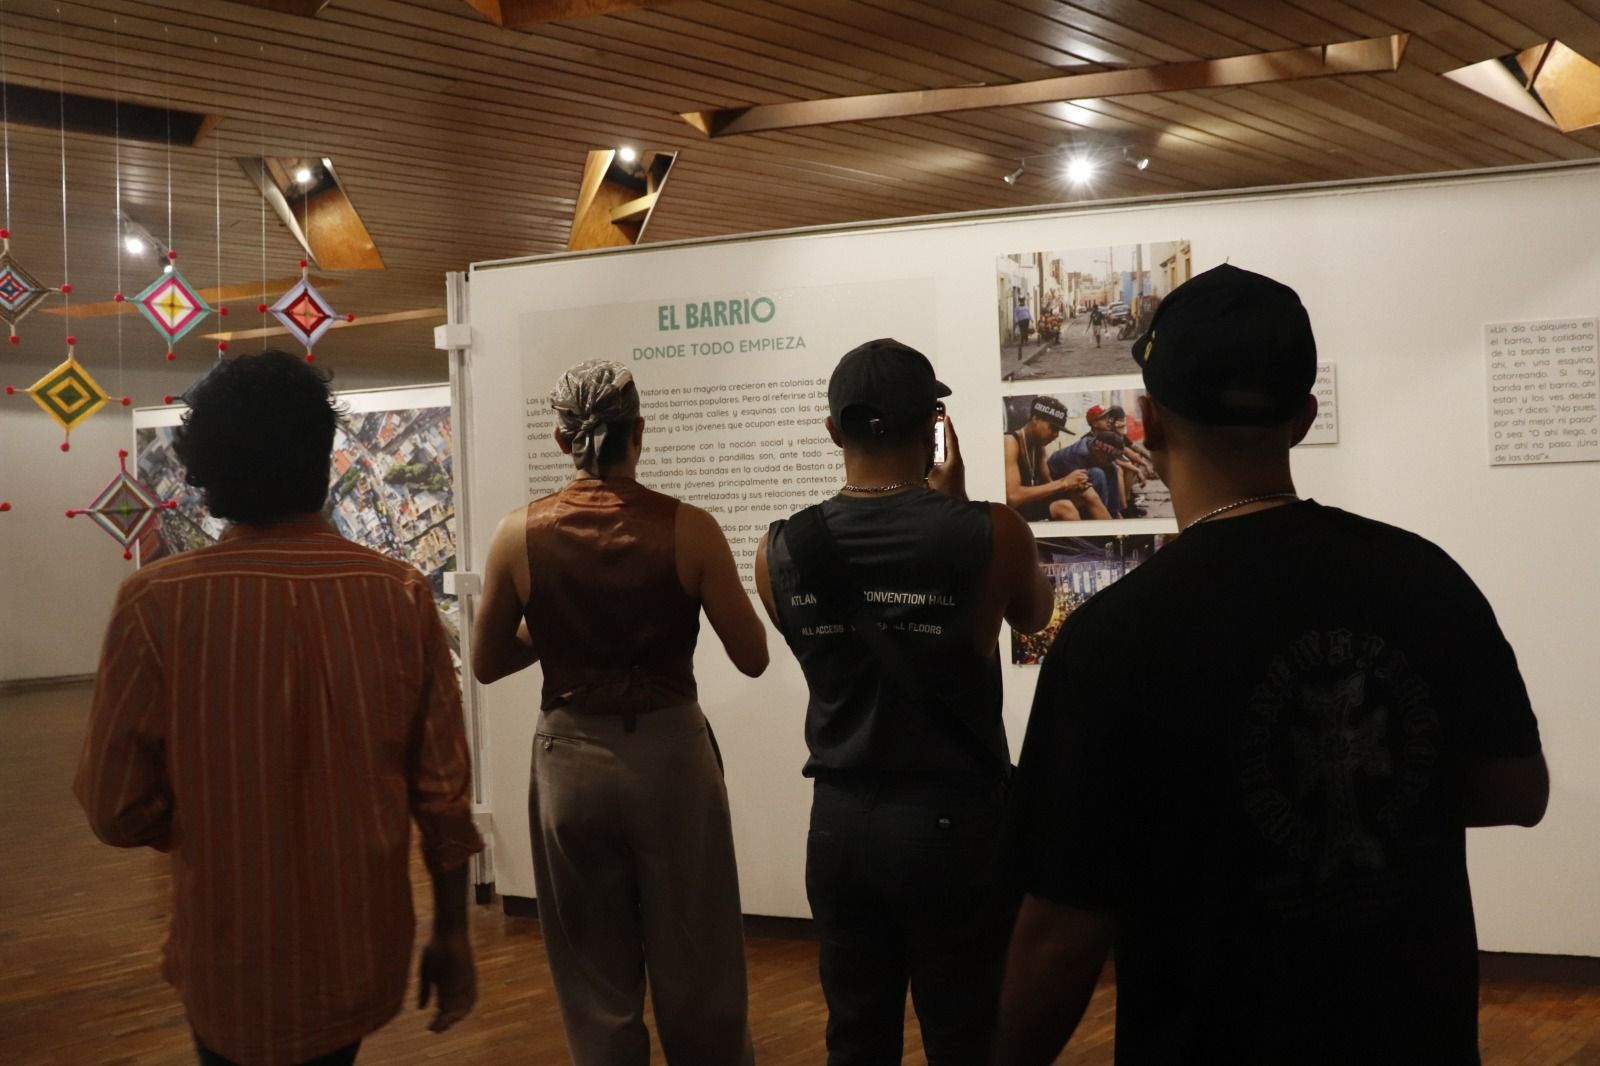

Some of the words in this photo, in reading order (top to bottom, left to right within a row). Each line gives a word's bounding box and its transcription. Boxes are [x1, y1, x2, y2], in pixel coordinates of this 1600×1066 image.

[658, 304, 680, 331] EL
[686, 297, 776, 329] BARRIO
[1530, 322, 1577, 331] cualquiera
[1552, 333, 1594, 342] cotidiano
[633, 345, 686, 360] DONDE
[691, 341, 735, 356] TODO
[740, 336, 806, 352] EMPIEZA
[1521, 347, 1550, 355] banda
[1533, 359, 1550, 367] una
[1578, 368, 1595, 376] hay
[641, 388, 669, 396] historia
[729, 380, 766, 391] crecieron
[1569, 392, 1596, 400] desde
[670, 399, 697, 407] barrios
[672, 412, 703, 421] algunas
[741, 407, 776, 416] esquinas
[668, 426, 673, 434] y
[695, 422, 725, 432] jóvenes
[728, 422, 743, 430] que
[745, 421, 775, 429] ocupan
[1494, 420, 1508, 428] por
[1529, 418, 1554, 426] mejor
[654, 444, 695, 453] superpone
[729, 440, 756, 449] noción
[760, 438, 784, 446] social
[797, 437, 833, 445] relacion
[676, 456, 705, 464] bandas
[718, 452, 754, 462] pandillas
[641, 469, 683, 477] estudiando
[699, 467, 728, 475] bandas
[731, 466, 741, 474] en
[685, 481, 714, 490] jóvenes
[718, 478, 778, 488] principalmente
[796, 475, 837, 483] contextos
[688, 492, 740, 501] entrelazadas
[742, 492, 747, 500] y
[864, 591, 926, 604] ONVENTION
[929, 594, 956, 606] HALL
[908, 623, 941, 635] FLOORS
